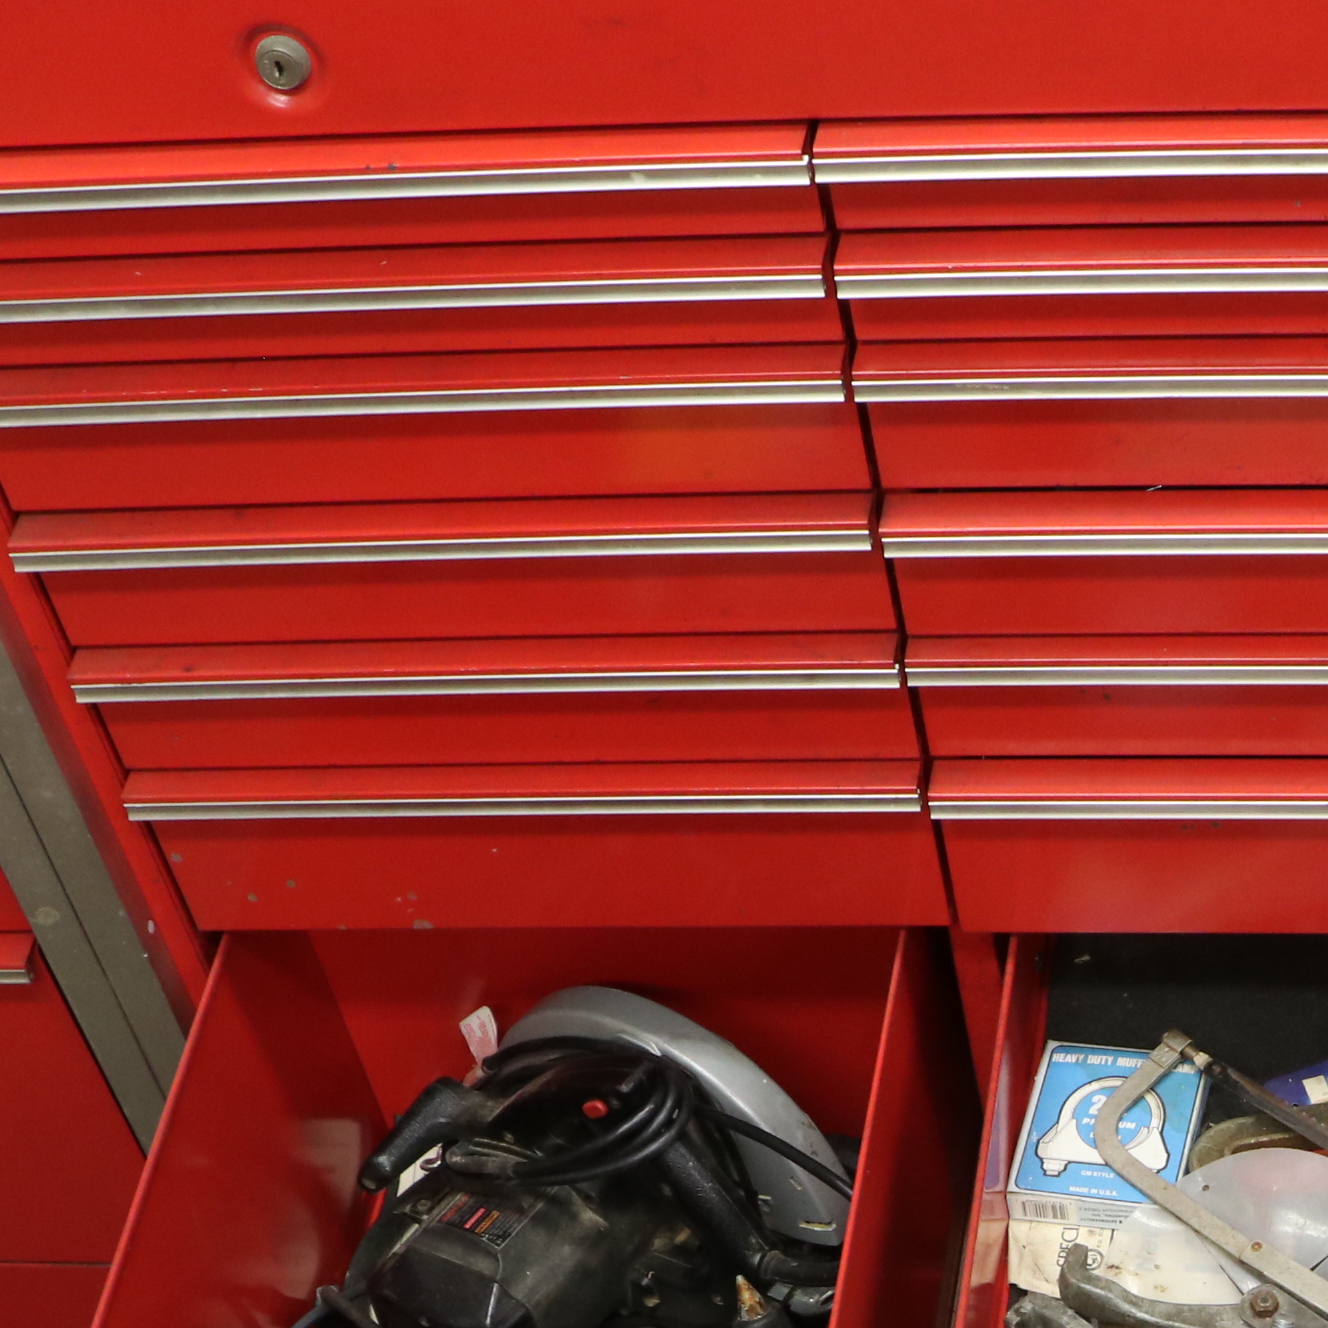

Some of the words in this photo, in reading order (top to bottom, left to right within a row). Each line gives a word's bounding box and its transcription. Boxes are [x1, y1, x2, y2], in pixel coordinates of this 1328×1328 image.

[1051, 1052, 1084, 1063] HEAVY
[1087, 1055, 1114, 1065] DUTY
[1116, 1056, 1148, 1068] MUFF
[1093, 1170, 1116, 1179] STYLE
[1069, 1185, 1090, 1194] MADE
